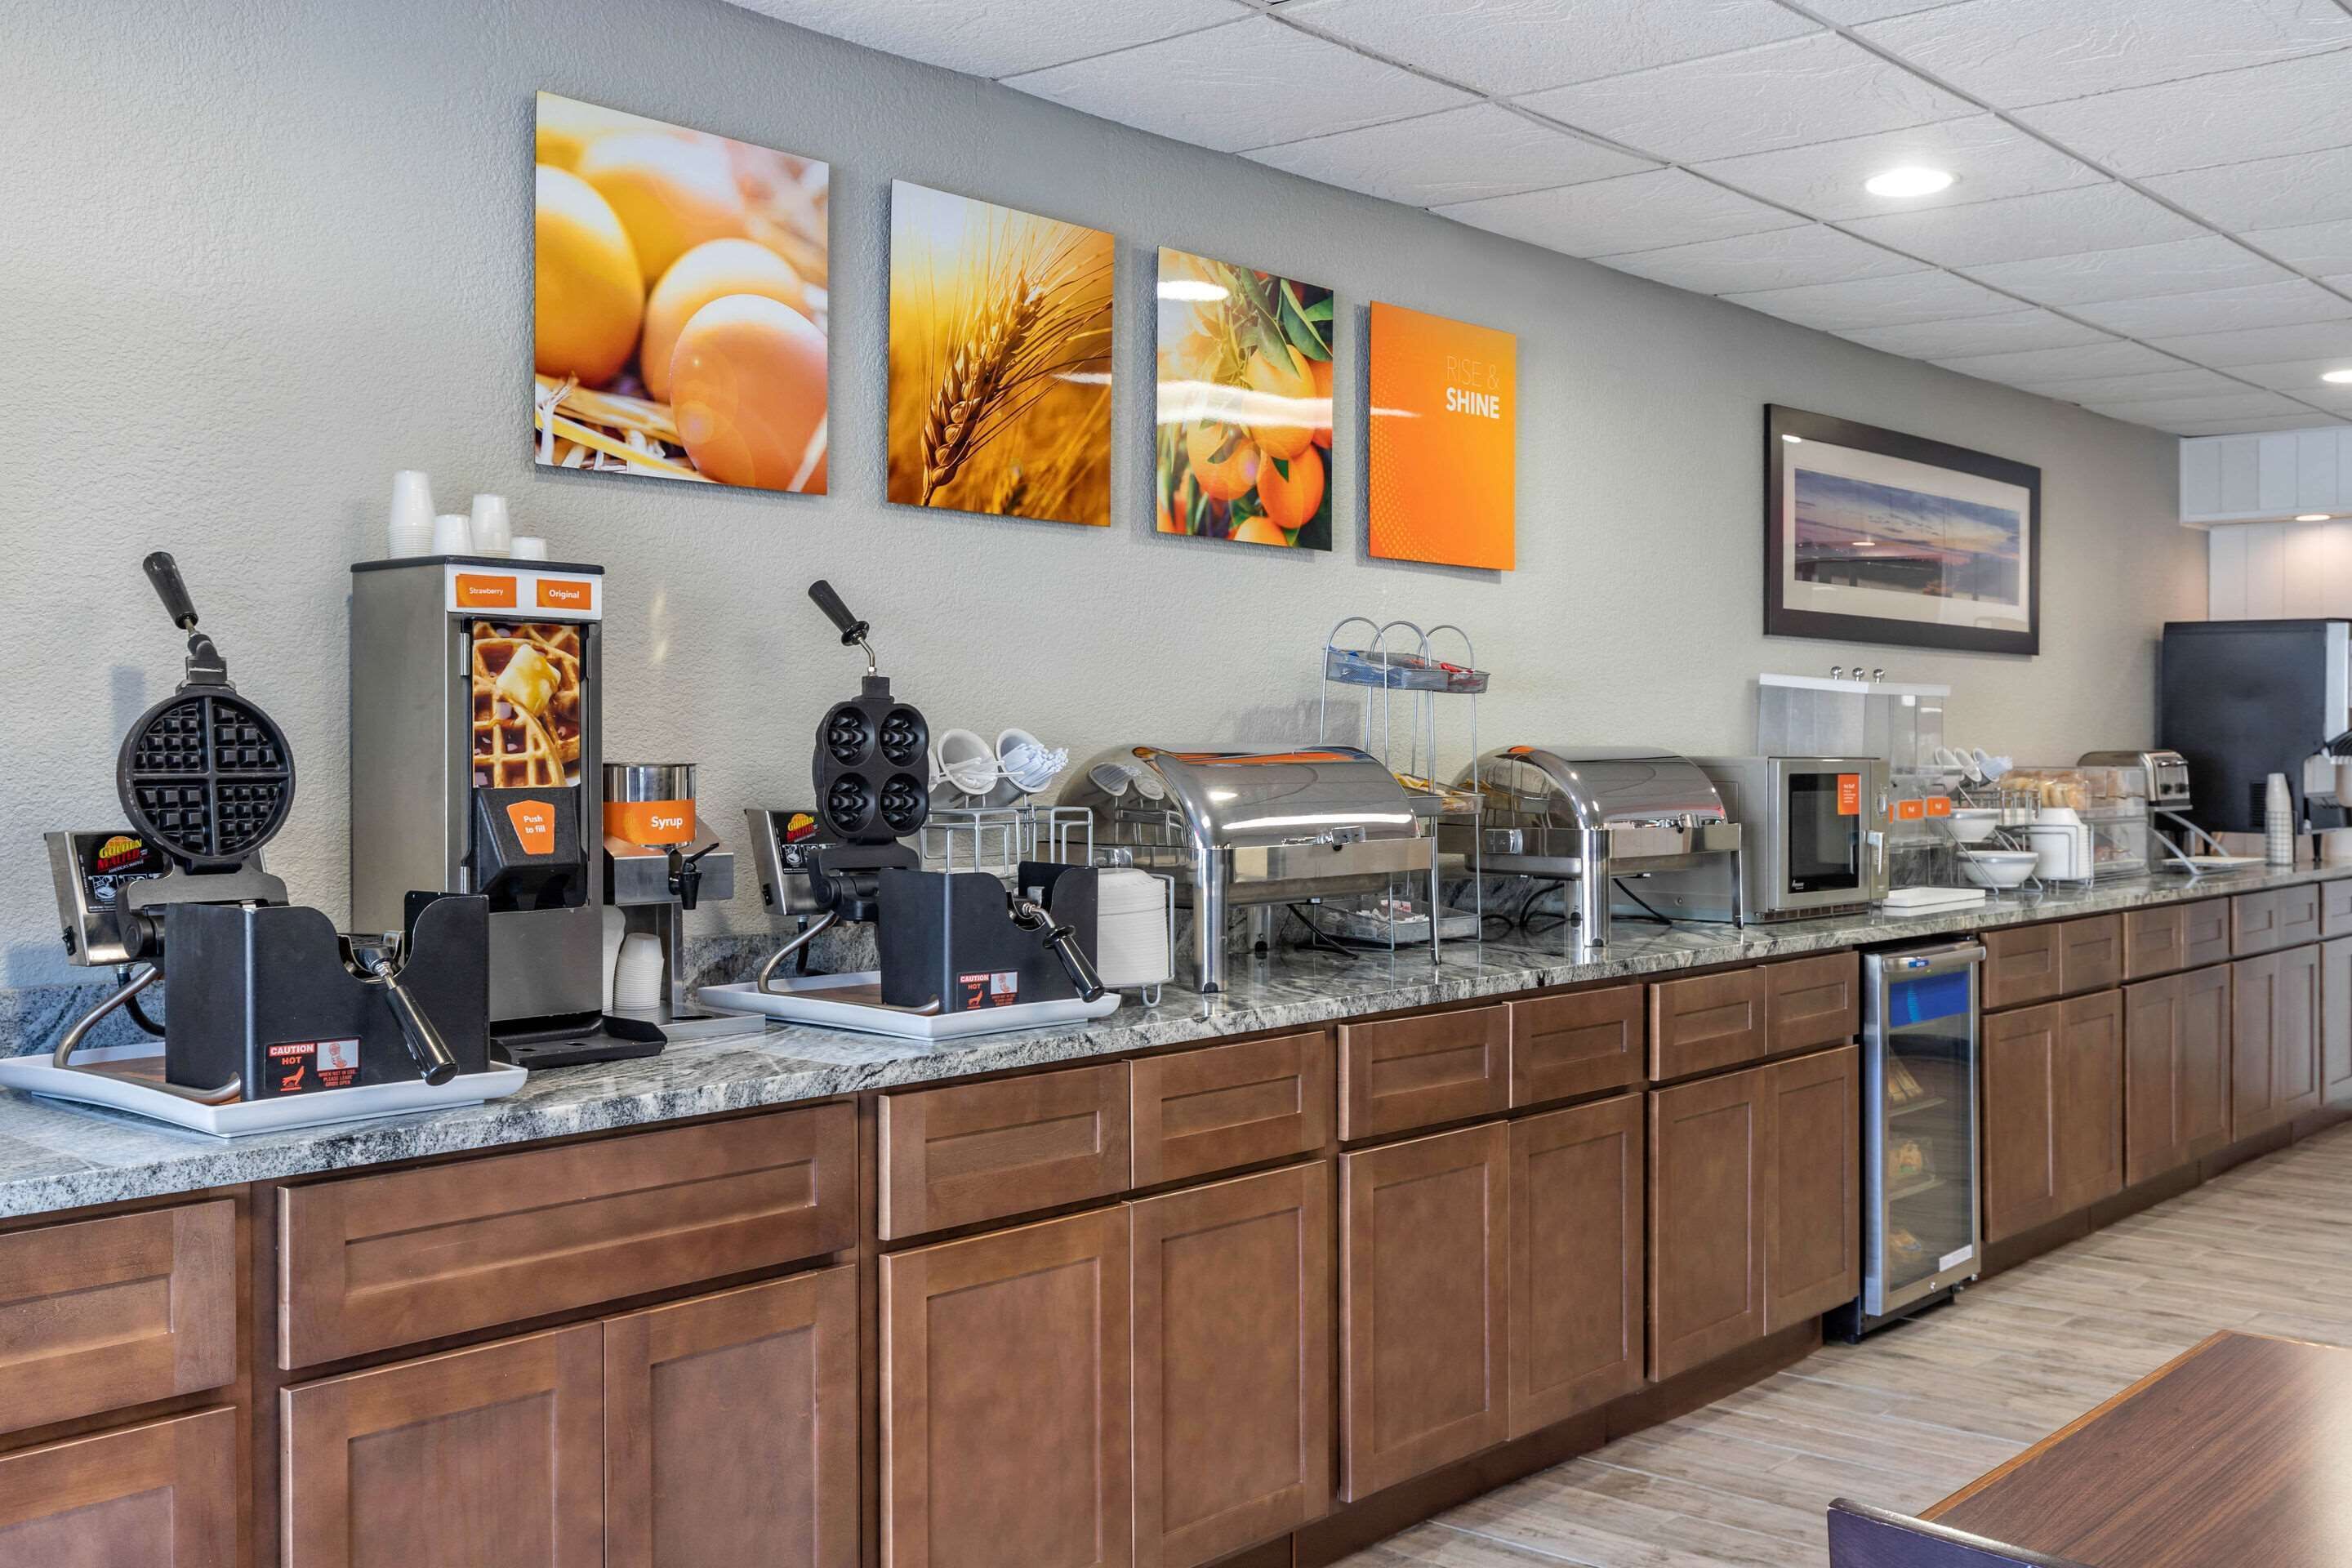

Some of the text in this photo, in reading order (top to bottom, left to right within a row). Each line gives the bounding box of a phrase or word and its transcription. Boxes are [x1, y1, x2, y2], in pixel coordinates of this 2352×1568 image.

[1446, 355, 1499, 390] RISE &
[1446, 386, 1500, 419] SHINE
[469, 586, 504, 596] Strawberry
[549, 589, 580, 600] Original
[523, 815, 543, 823] Push
[651, 816, 684, 831] Syrup
[535, 825, 546, 833] fill
[99, 839, 143, 859] GOLDEN
[960, 974, 990, 982] CAUTION
[270, 1045, 314, 1055] CAUTION
[282, 1057, 302, 1066] HOT
